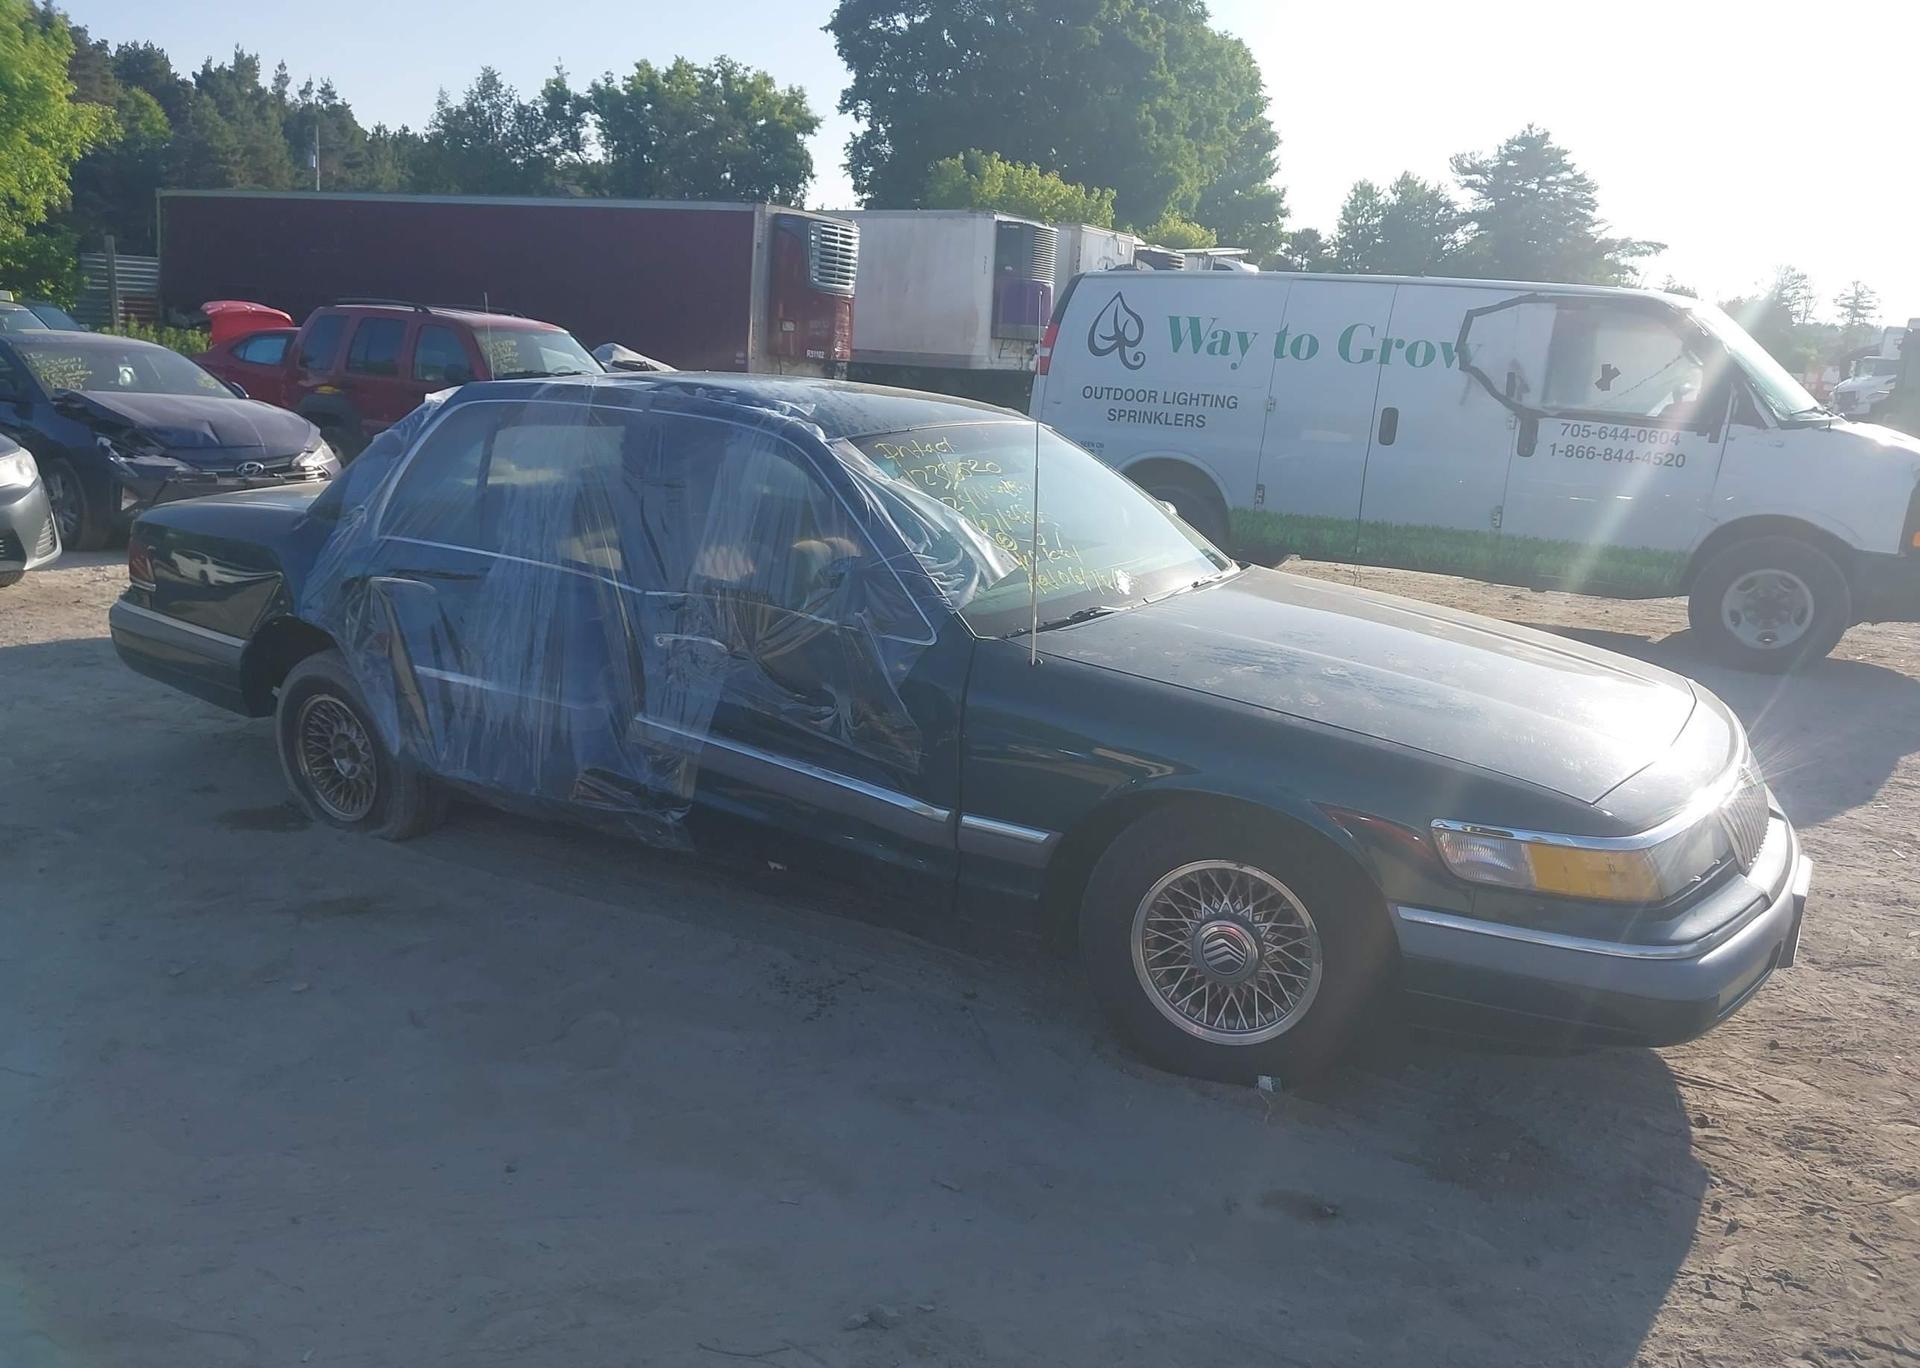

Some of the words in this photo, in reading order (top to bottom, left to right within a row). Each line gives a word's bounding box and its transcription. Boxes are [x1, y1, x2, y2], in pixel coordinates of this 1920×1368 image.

[1168, 315, 1259, 371] Way
[1274, 323, 1320, 361] to
[1082, 385, 1158, 404] OUTDOOR
[1162, 391, 1239, 410] LIGHTING
[1107, 407, 1207, 429] SPRINKLERS
[1560, 422, 1681, 446] 705-644-0604
[1549, 442, 1687, 468] 1-866-844-4520
